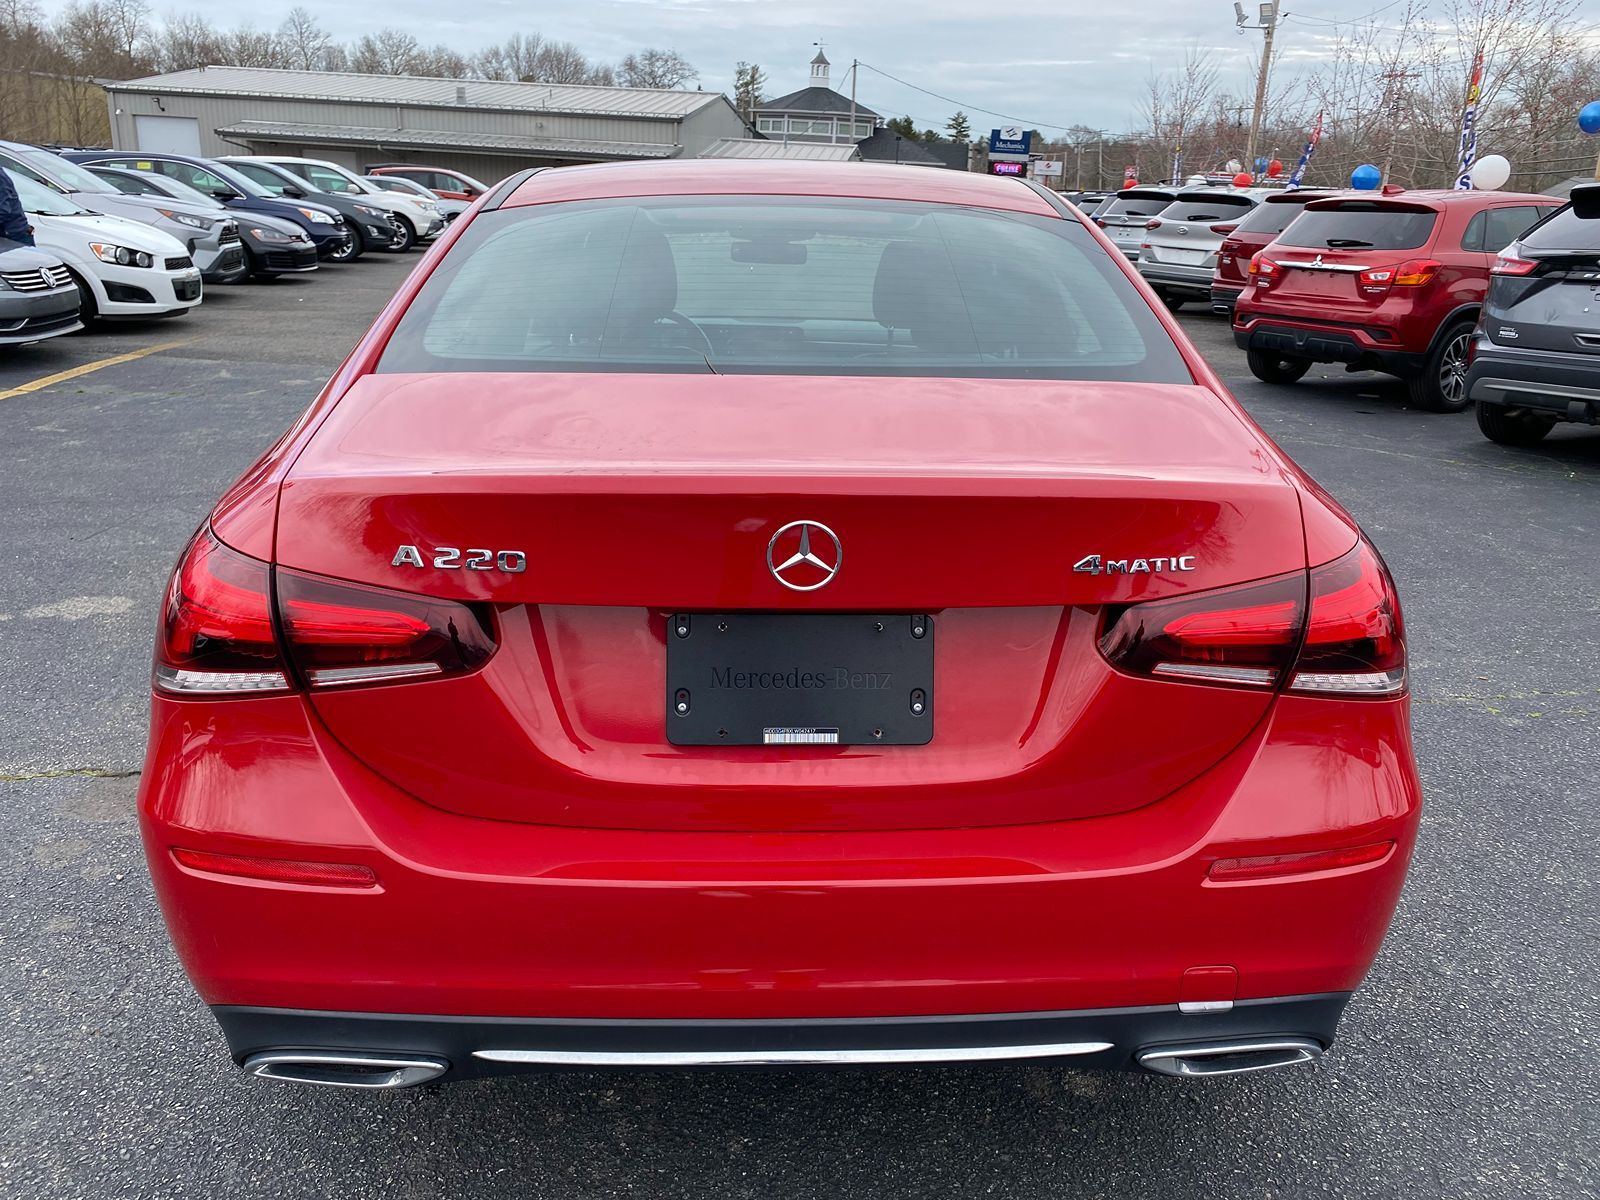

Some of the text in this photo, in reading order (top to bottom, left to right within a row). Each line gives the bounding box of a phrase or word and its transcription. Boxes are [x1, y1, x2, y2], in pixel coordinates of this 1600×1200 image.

[391, 544, 527, 573] A 220
[1073, 554, 1196, 576] 4MATIC
[710, 666, 893, 690] Mercedes-Benz
